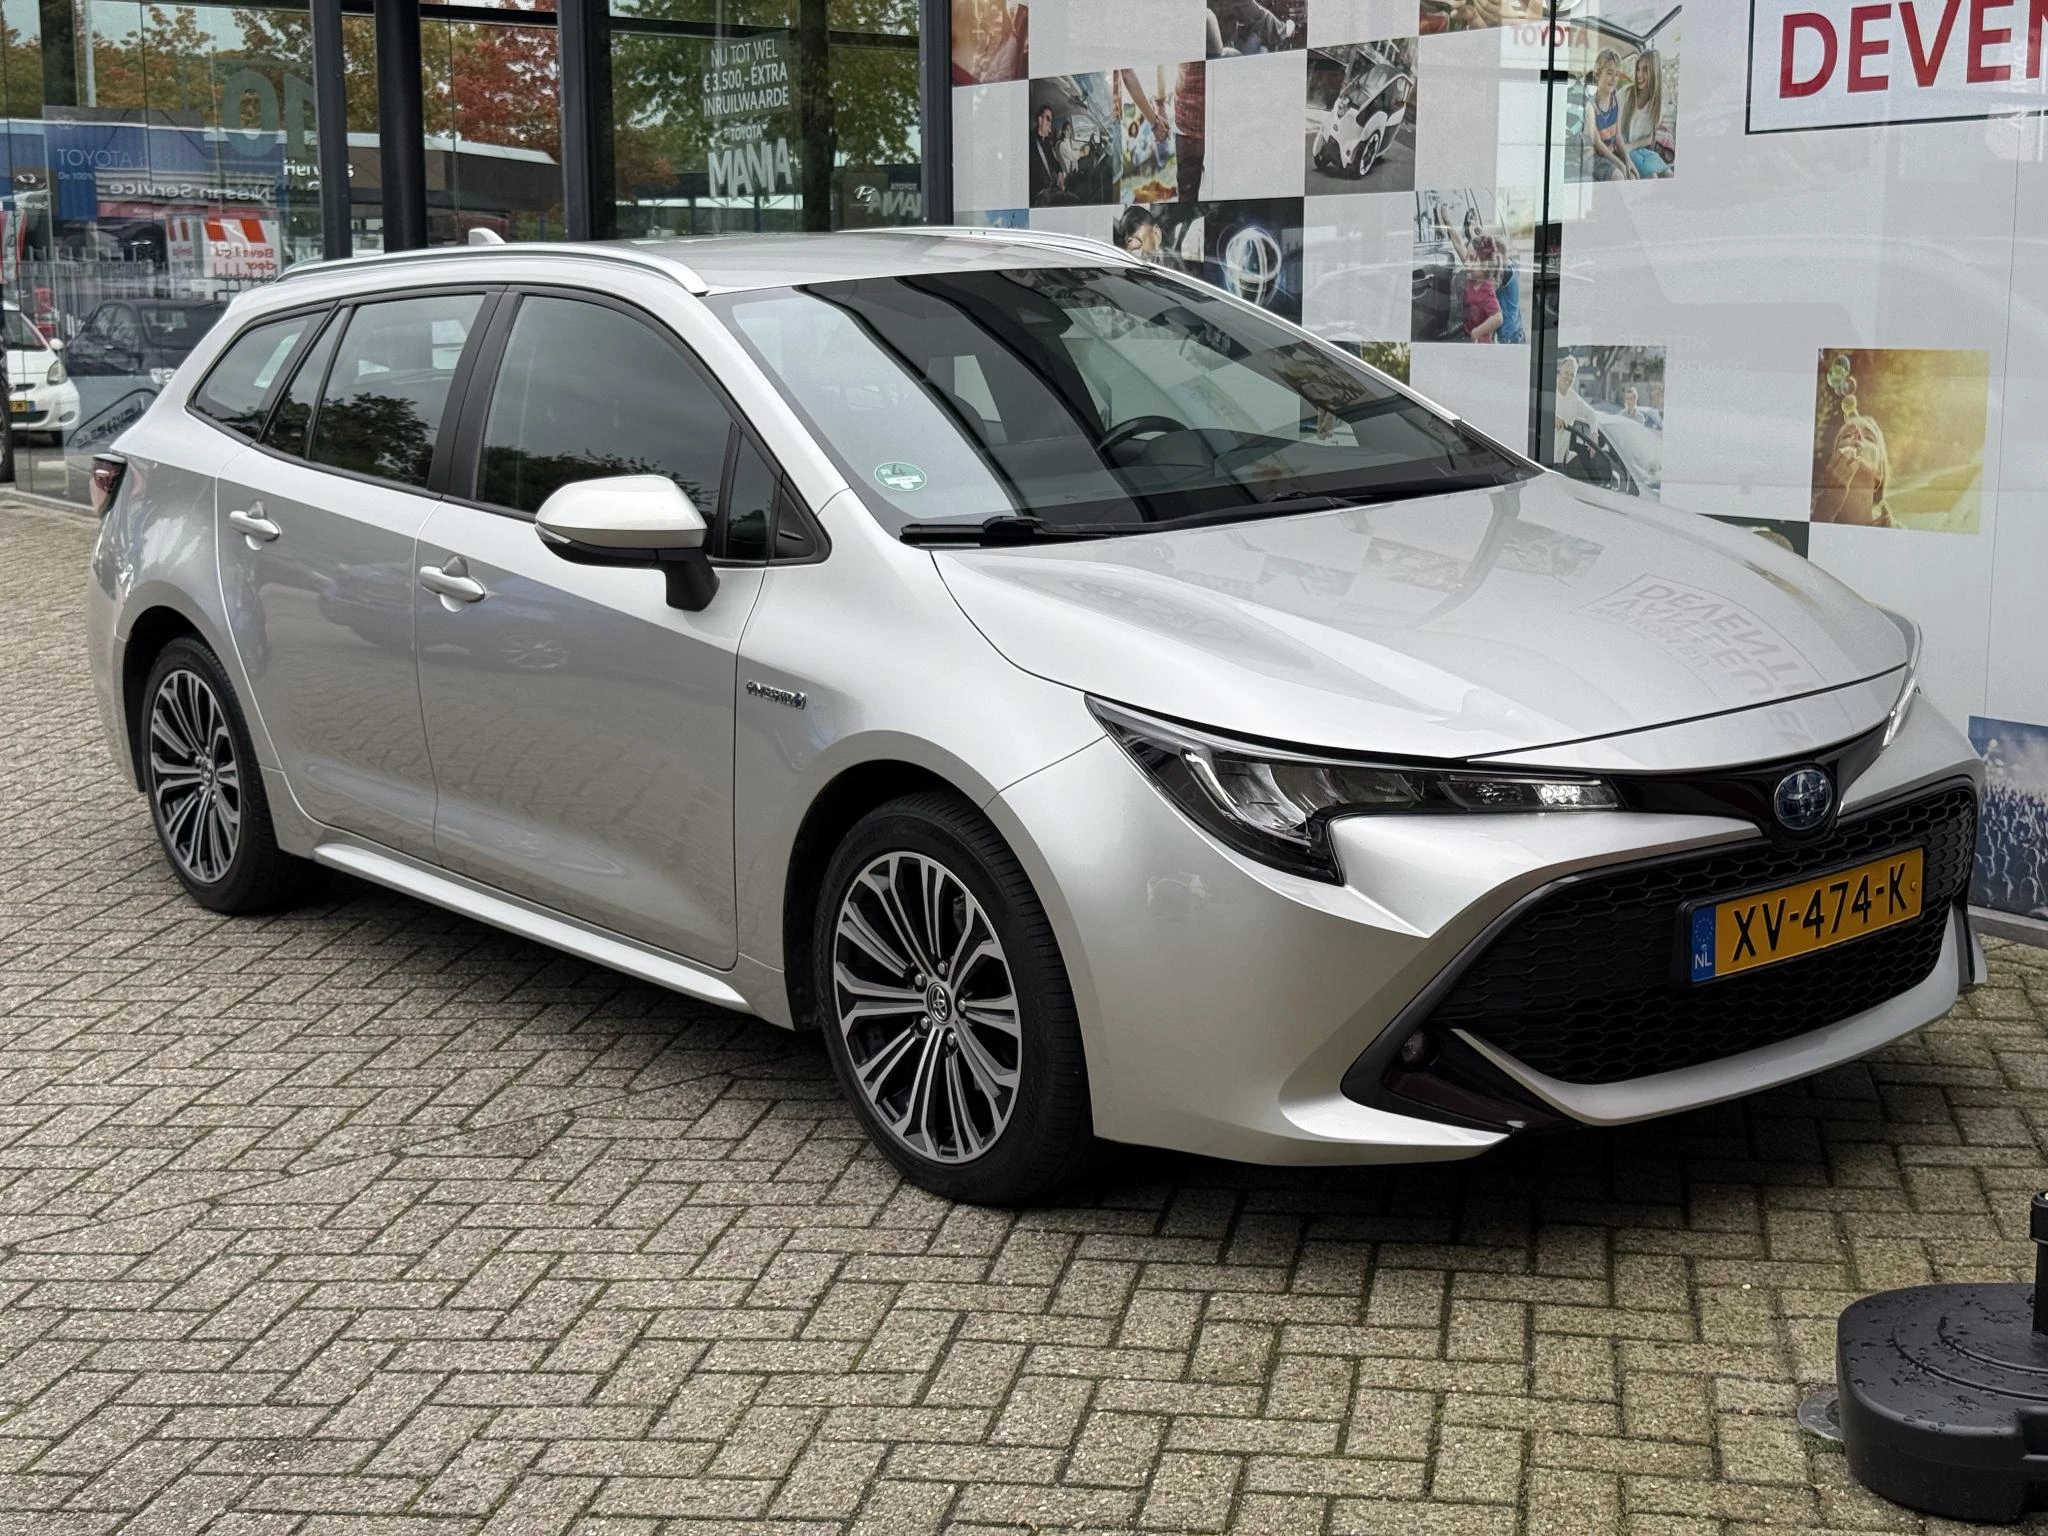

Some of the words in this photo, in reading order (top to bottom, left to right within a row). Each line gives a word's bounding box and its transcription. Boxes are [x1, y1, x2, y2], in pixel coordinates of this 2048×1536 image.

[1511, 23, 1590, 48] TOYOTA
[711, 47, 728, 68] NU
[730, 42, 751, 64] TOT
[753, 38, 779, 60] WEL
[703, 85, 790, 117] INRUILWAARDE
[730, 124, 763, 141] TOYOTA
[57, 148, 133, 167] TOYOTA
[707, 137, 793, 201] MANIA
[1731, 862, 1908, 962] XV-474-K
[1694, 953, 1712, 970] NL
